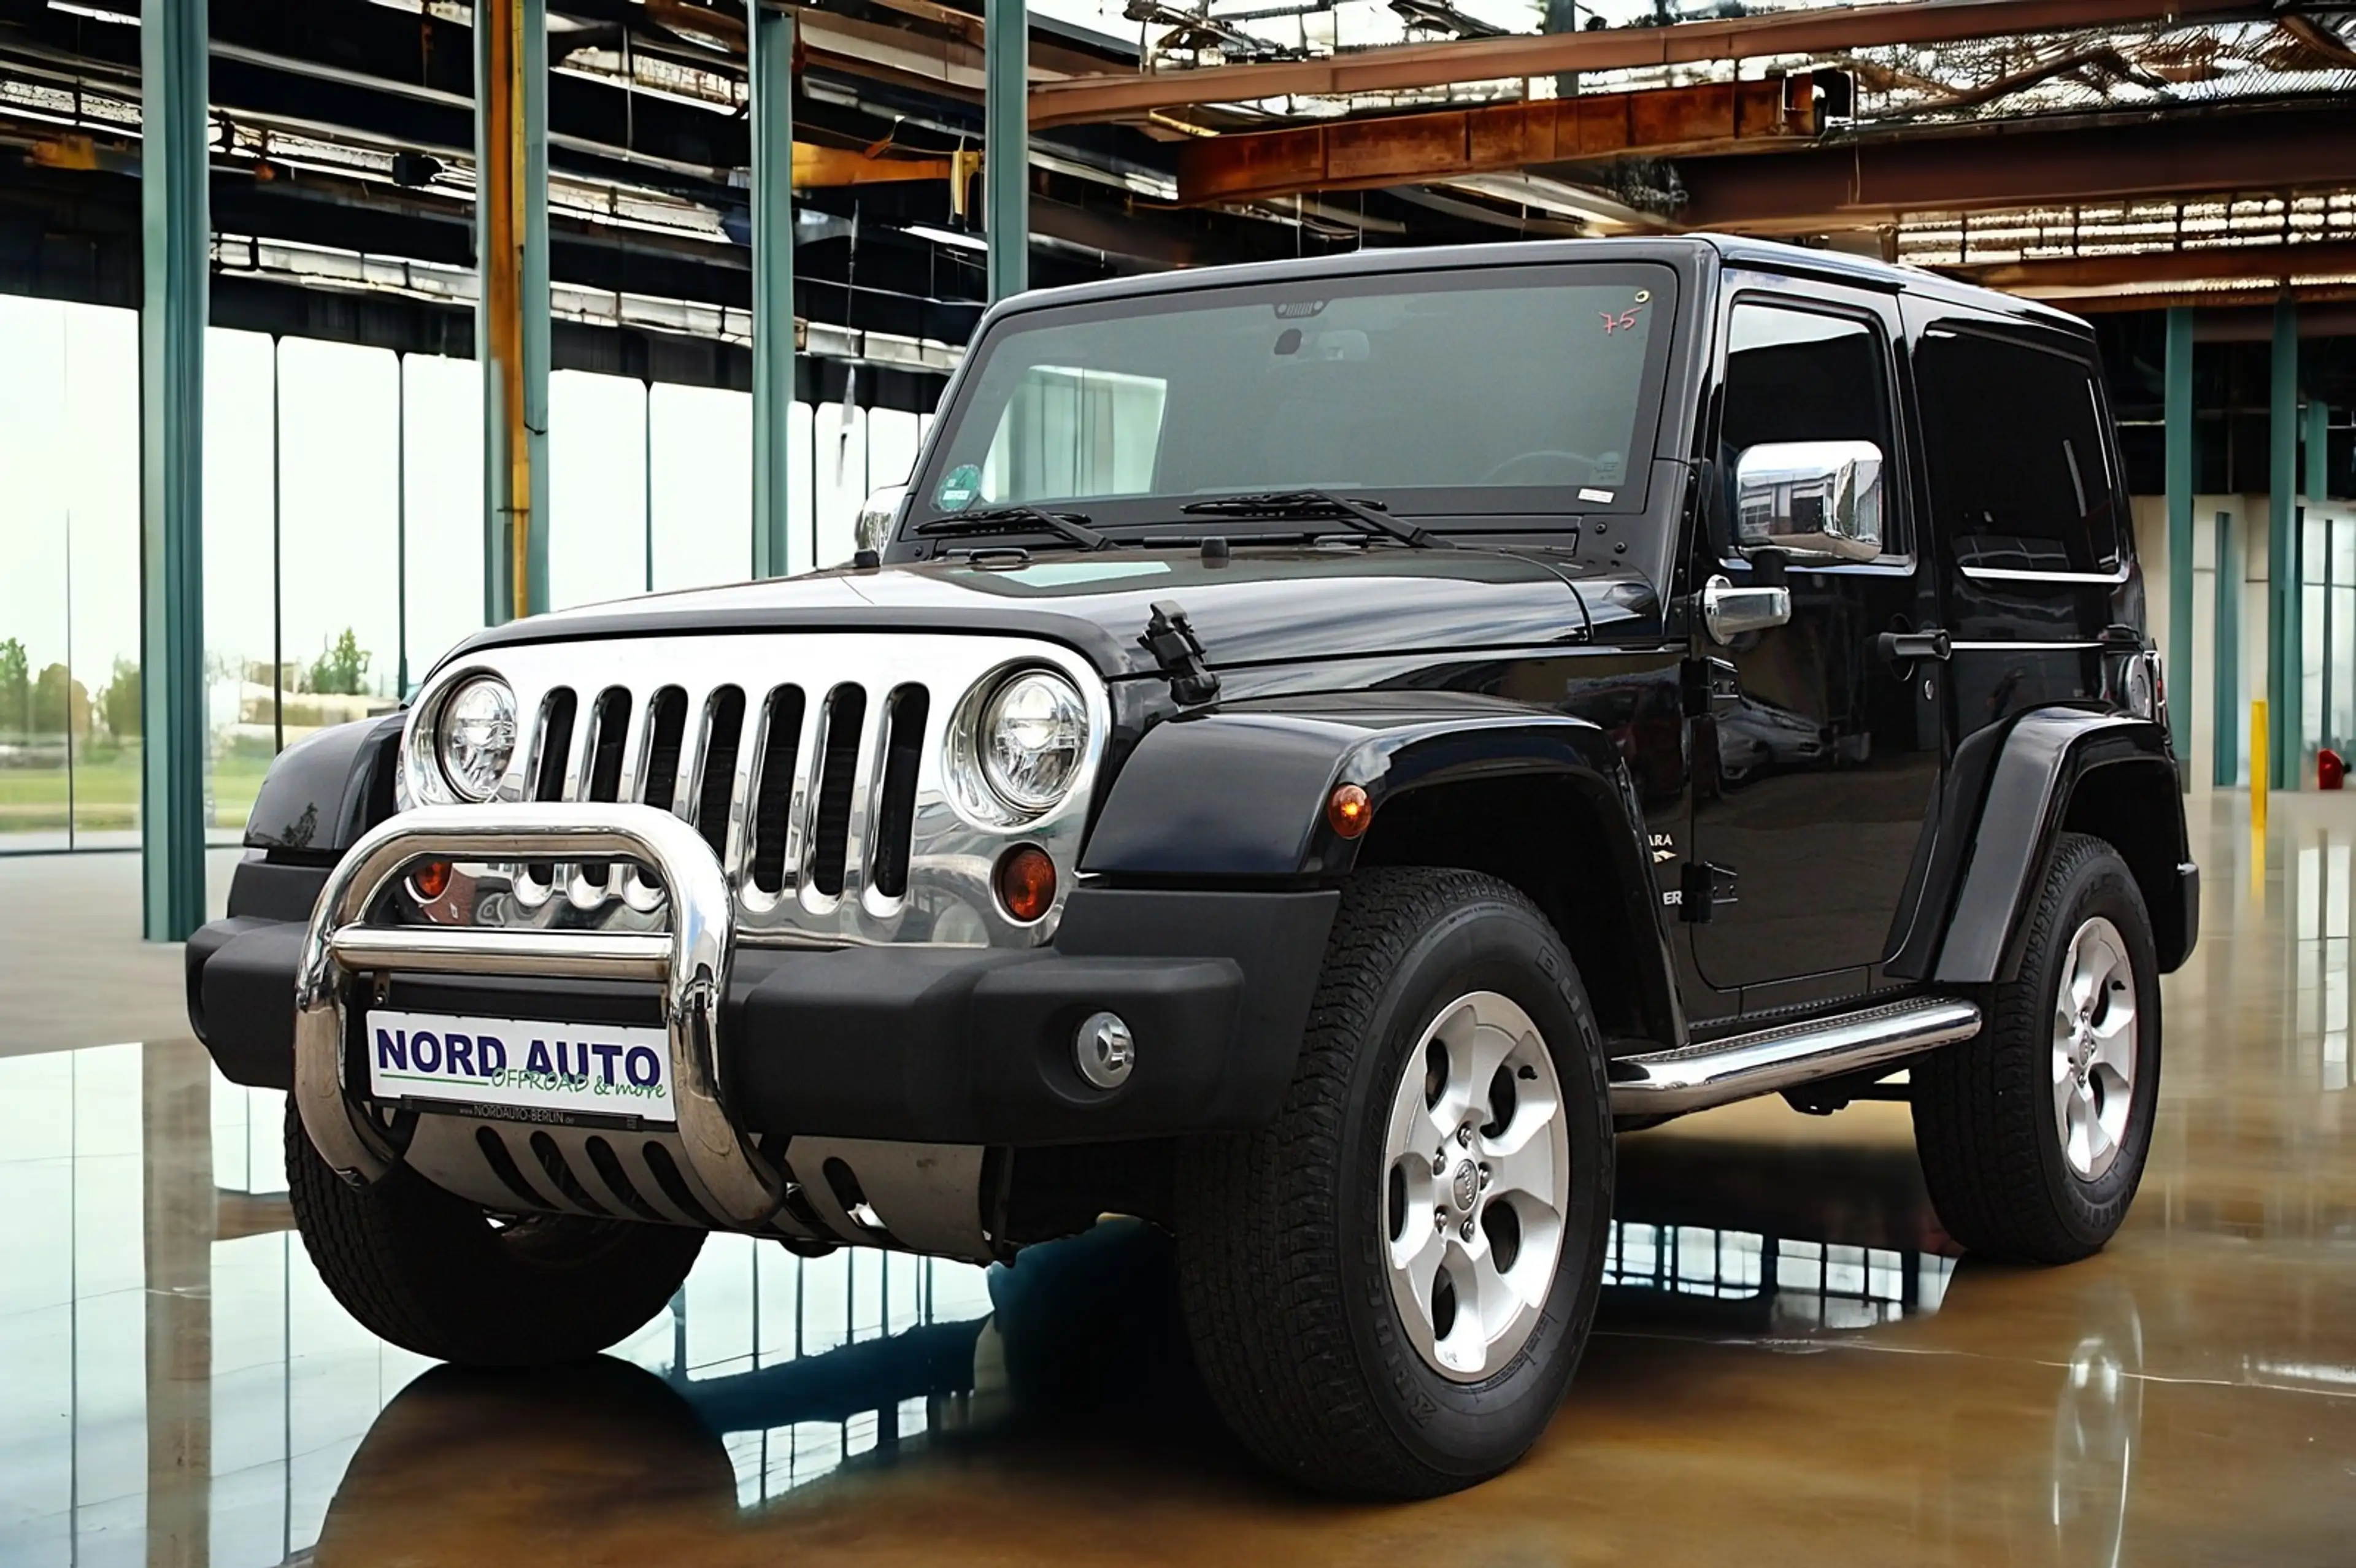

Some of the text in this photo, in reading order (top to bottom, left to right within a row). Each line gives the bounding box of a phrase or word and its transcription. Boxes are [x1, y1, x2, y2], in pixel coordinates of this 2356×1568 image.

[375, 1028, 661, 1088] NORD AUTO
[491, 1067, 666, 1099] OFFROAD & more
